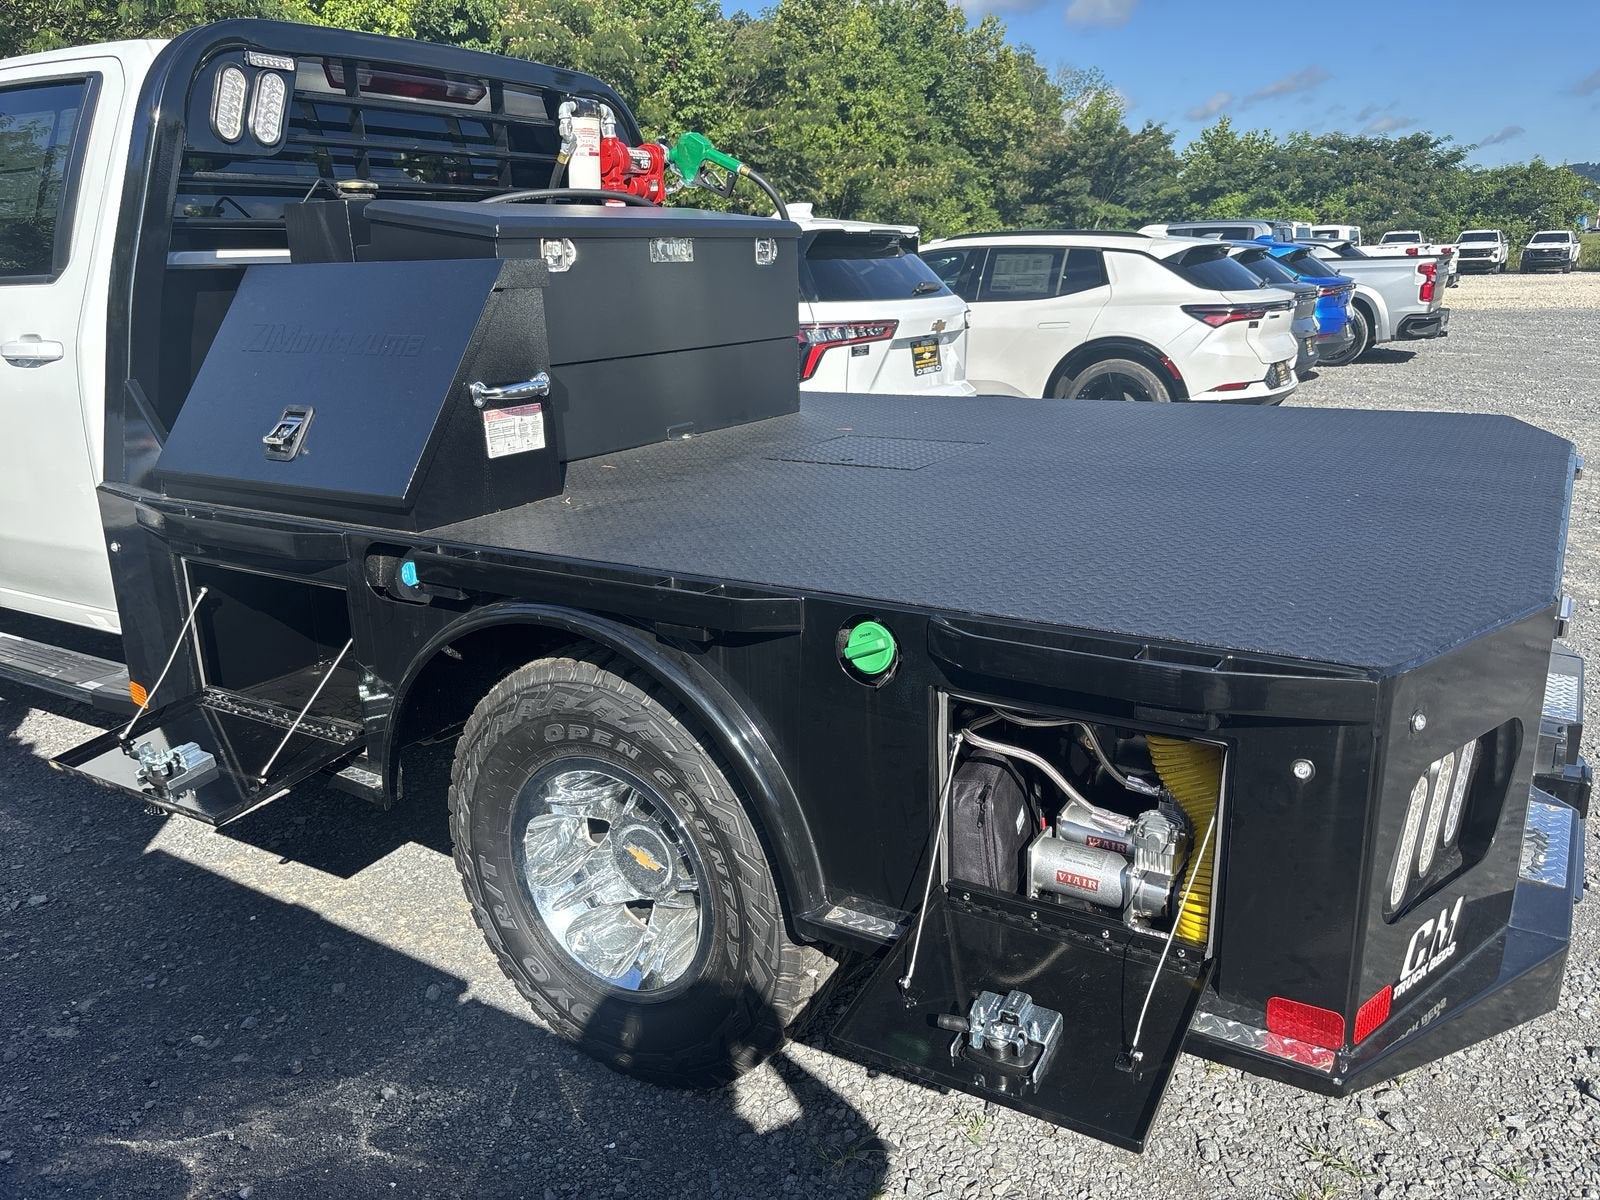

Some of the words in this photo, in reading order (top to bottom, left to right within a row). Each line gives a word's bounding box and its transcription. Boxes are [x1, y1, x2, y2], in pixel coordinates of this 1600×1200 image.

[666, 243, 687, 256] UWS
[544, 723, 642, 760] OPEN
[652, 768, 740, 970] COUNTRY
[1087, 836, 1128, 854] VIAIR
[478, 854, 518, 930] R/T
[1057, 871, 1098, 890] VIAIR
[1400, 896, 1464, 981] CM
[1393, 963, 1429, 1000] TRUCK
[1428, 941, 1457, 973] BEDS
